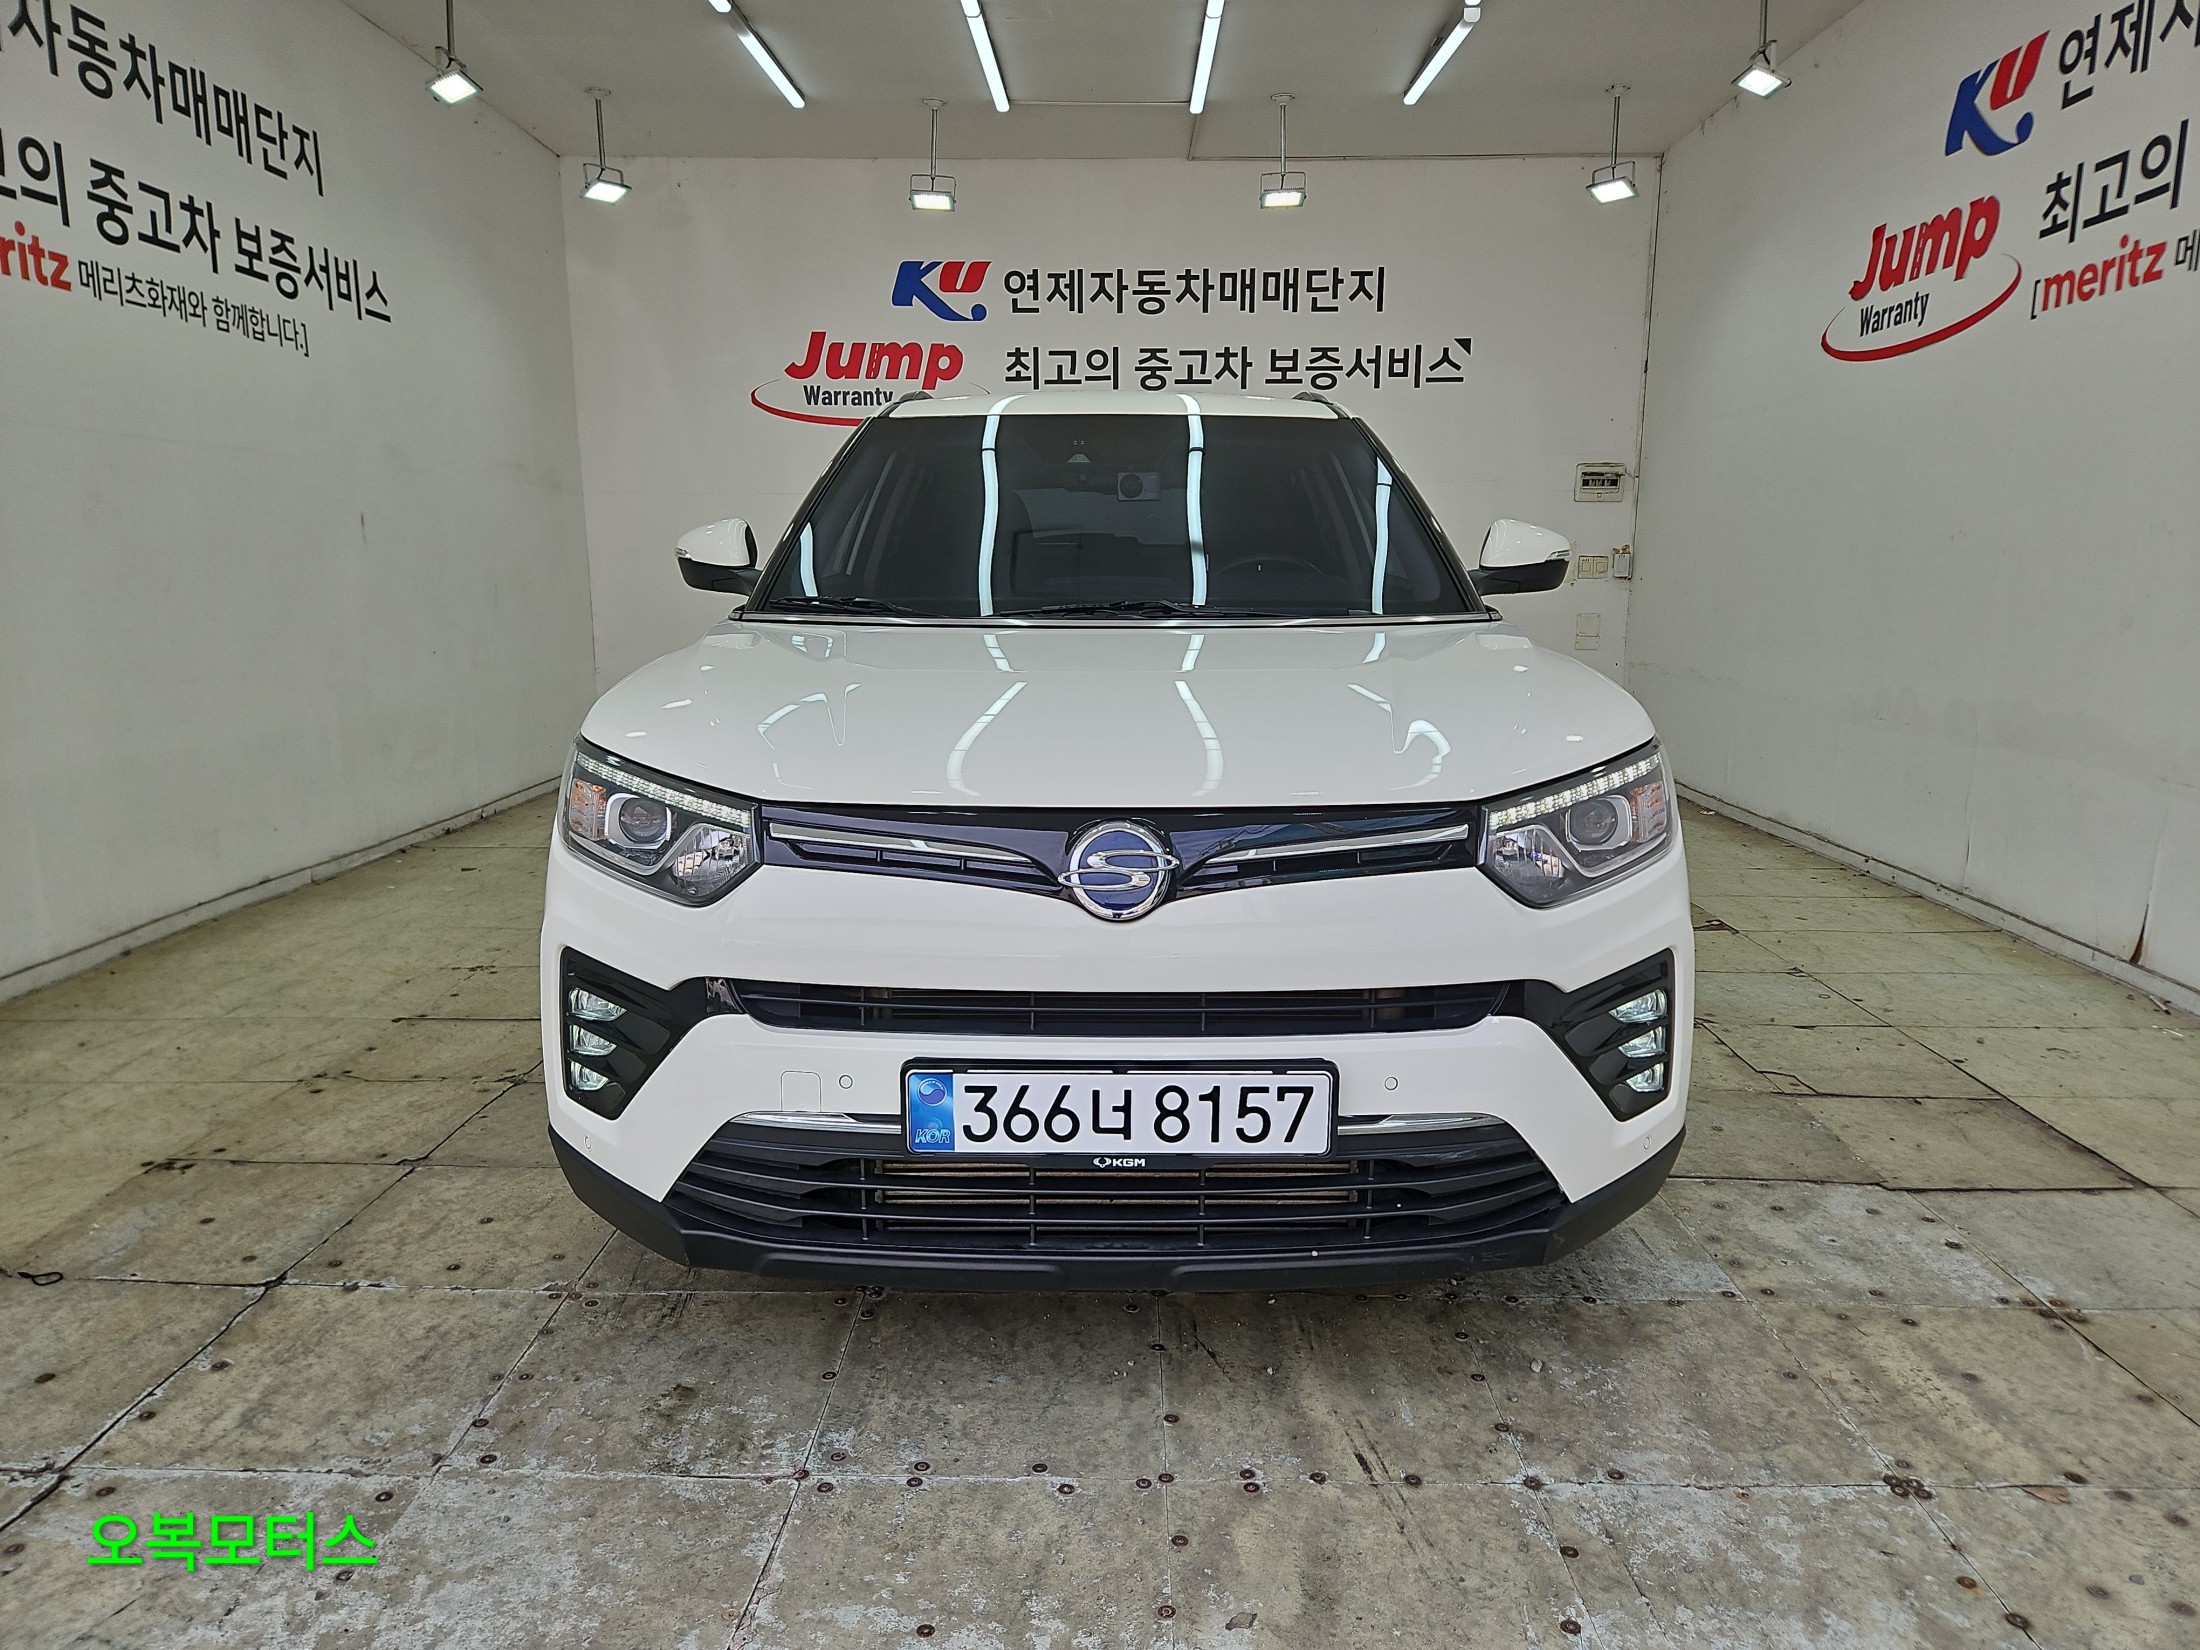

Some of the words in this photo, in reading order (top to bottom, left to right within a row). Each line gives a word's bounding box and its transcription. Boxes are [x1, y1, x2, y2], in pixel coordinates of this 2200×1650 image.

[0, 0, 324, 197] 자동차매매단지
[2038, 118, 2190, 244] 최고의
[86, 158, 221, 274] 중고차
[234, 217, 392, 323] 보증서비스
[1848, 195, 2000, 301] Jump
[78, 259, 208, 328] 메리츠화재와
[1003, 267, 1386, 315] 연제자동차매매단지
[1859, 292, 1930, 338] Warranty
[784, 331, 964, 390] Jump
[1004, 346, 1120, 391] 최고의
[1134, 346, 1253, 391] 중고차
[1264, 344, 1465, 390] 보증서비스
[915, 1128, 951, 1144] KOR
[962, 1084, 1132, 1143] 366너
[1153, 1085, 1315, 1143] 8157
[1112, 1158, 1146, 1167] KGM
